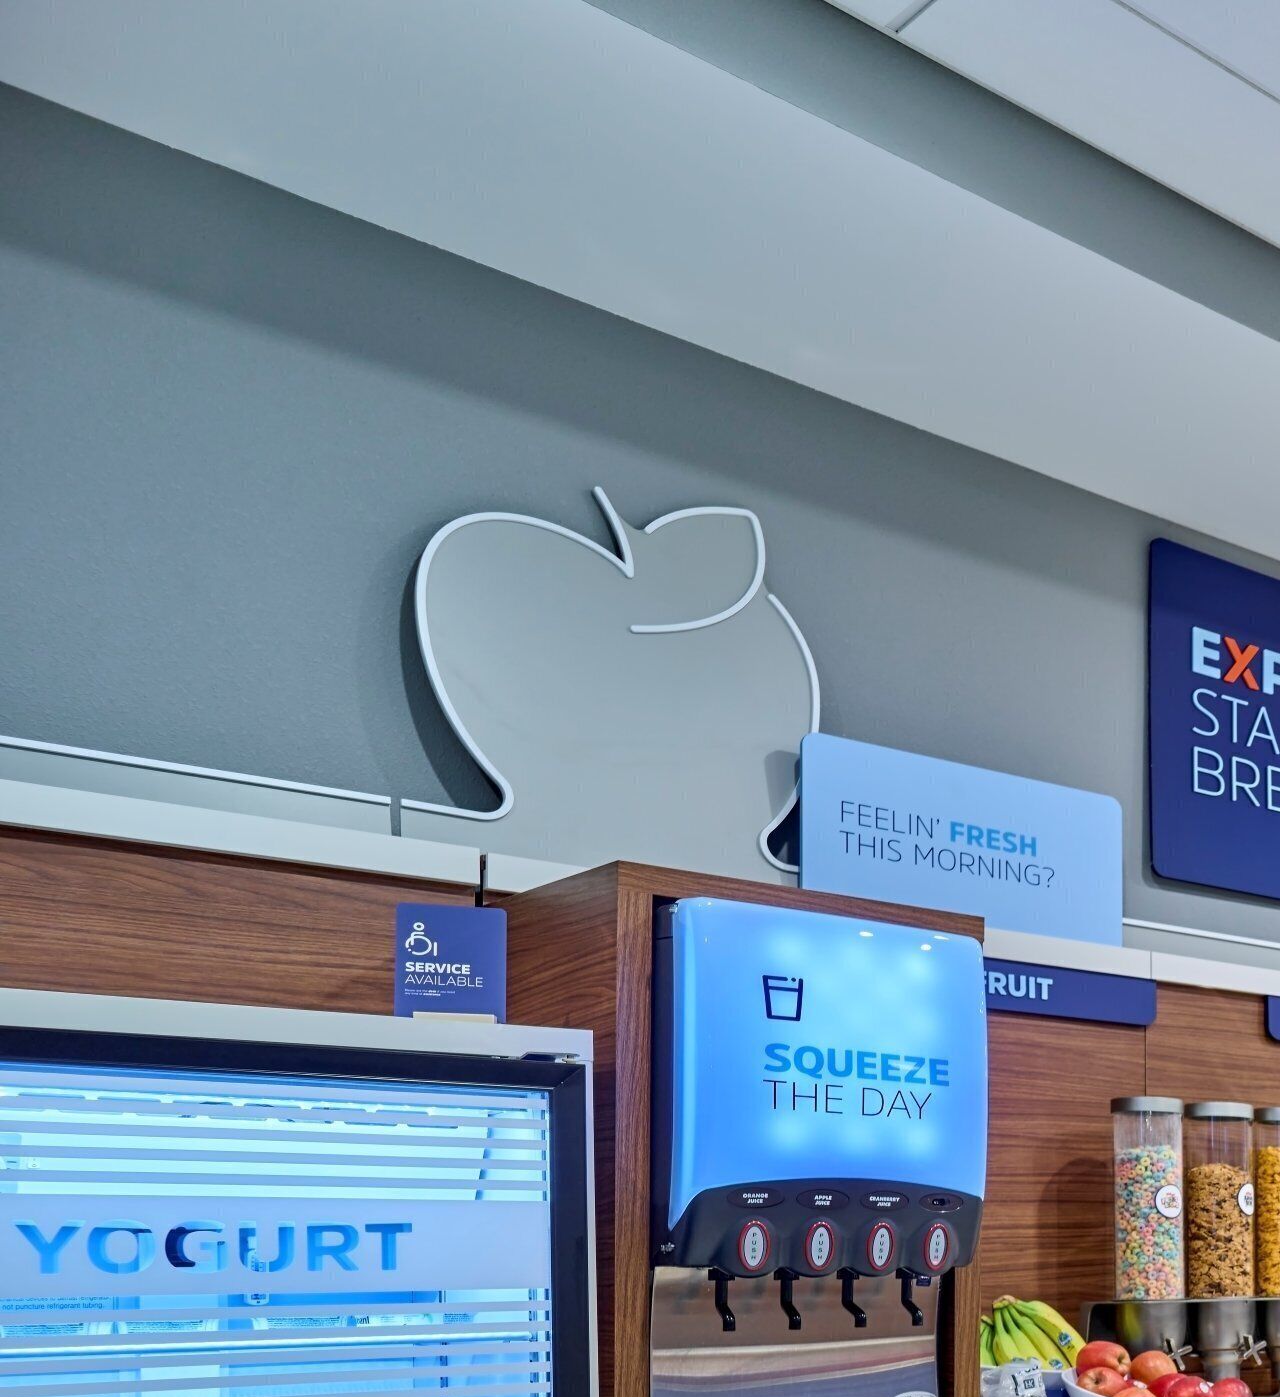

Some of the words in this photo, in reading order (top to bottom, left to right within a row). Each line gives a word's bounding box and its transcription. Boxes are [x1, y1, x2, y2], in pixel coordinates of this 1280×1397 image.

[841, 800, 940, 839] FEELIN'
[950, 821, 1037, 857] FRESH
[839, 830, 902, 863] THIS
[914, 844, 1055, 888] MORNING?
[404, 961, 471, 975] SERVICE
[404, 974, 484, 988] AVAILABLE
[984, 970, 1053, 1001] RUIT
[763, 1043, 950, 1087] SQUEEZE
[763, 1079, 844, 1115] THE
[861, 1087, 932, 1120] DAY
[869, 1195, 901, 1203] CRANBERRY
[14, 1218, 413, 1275] YOGURT
